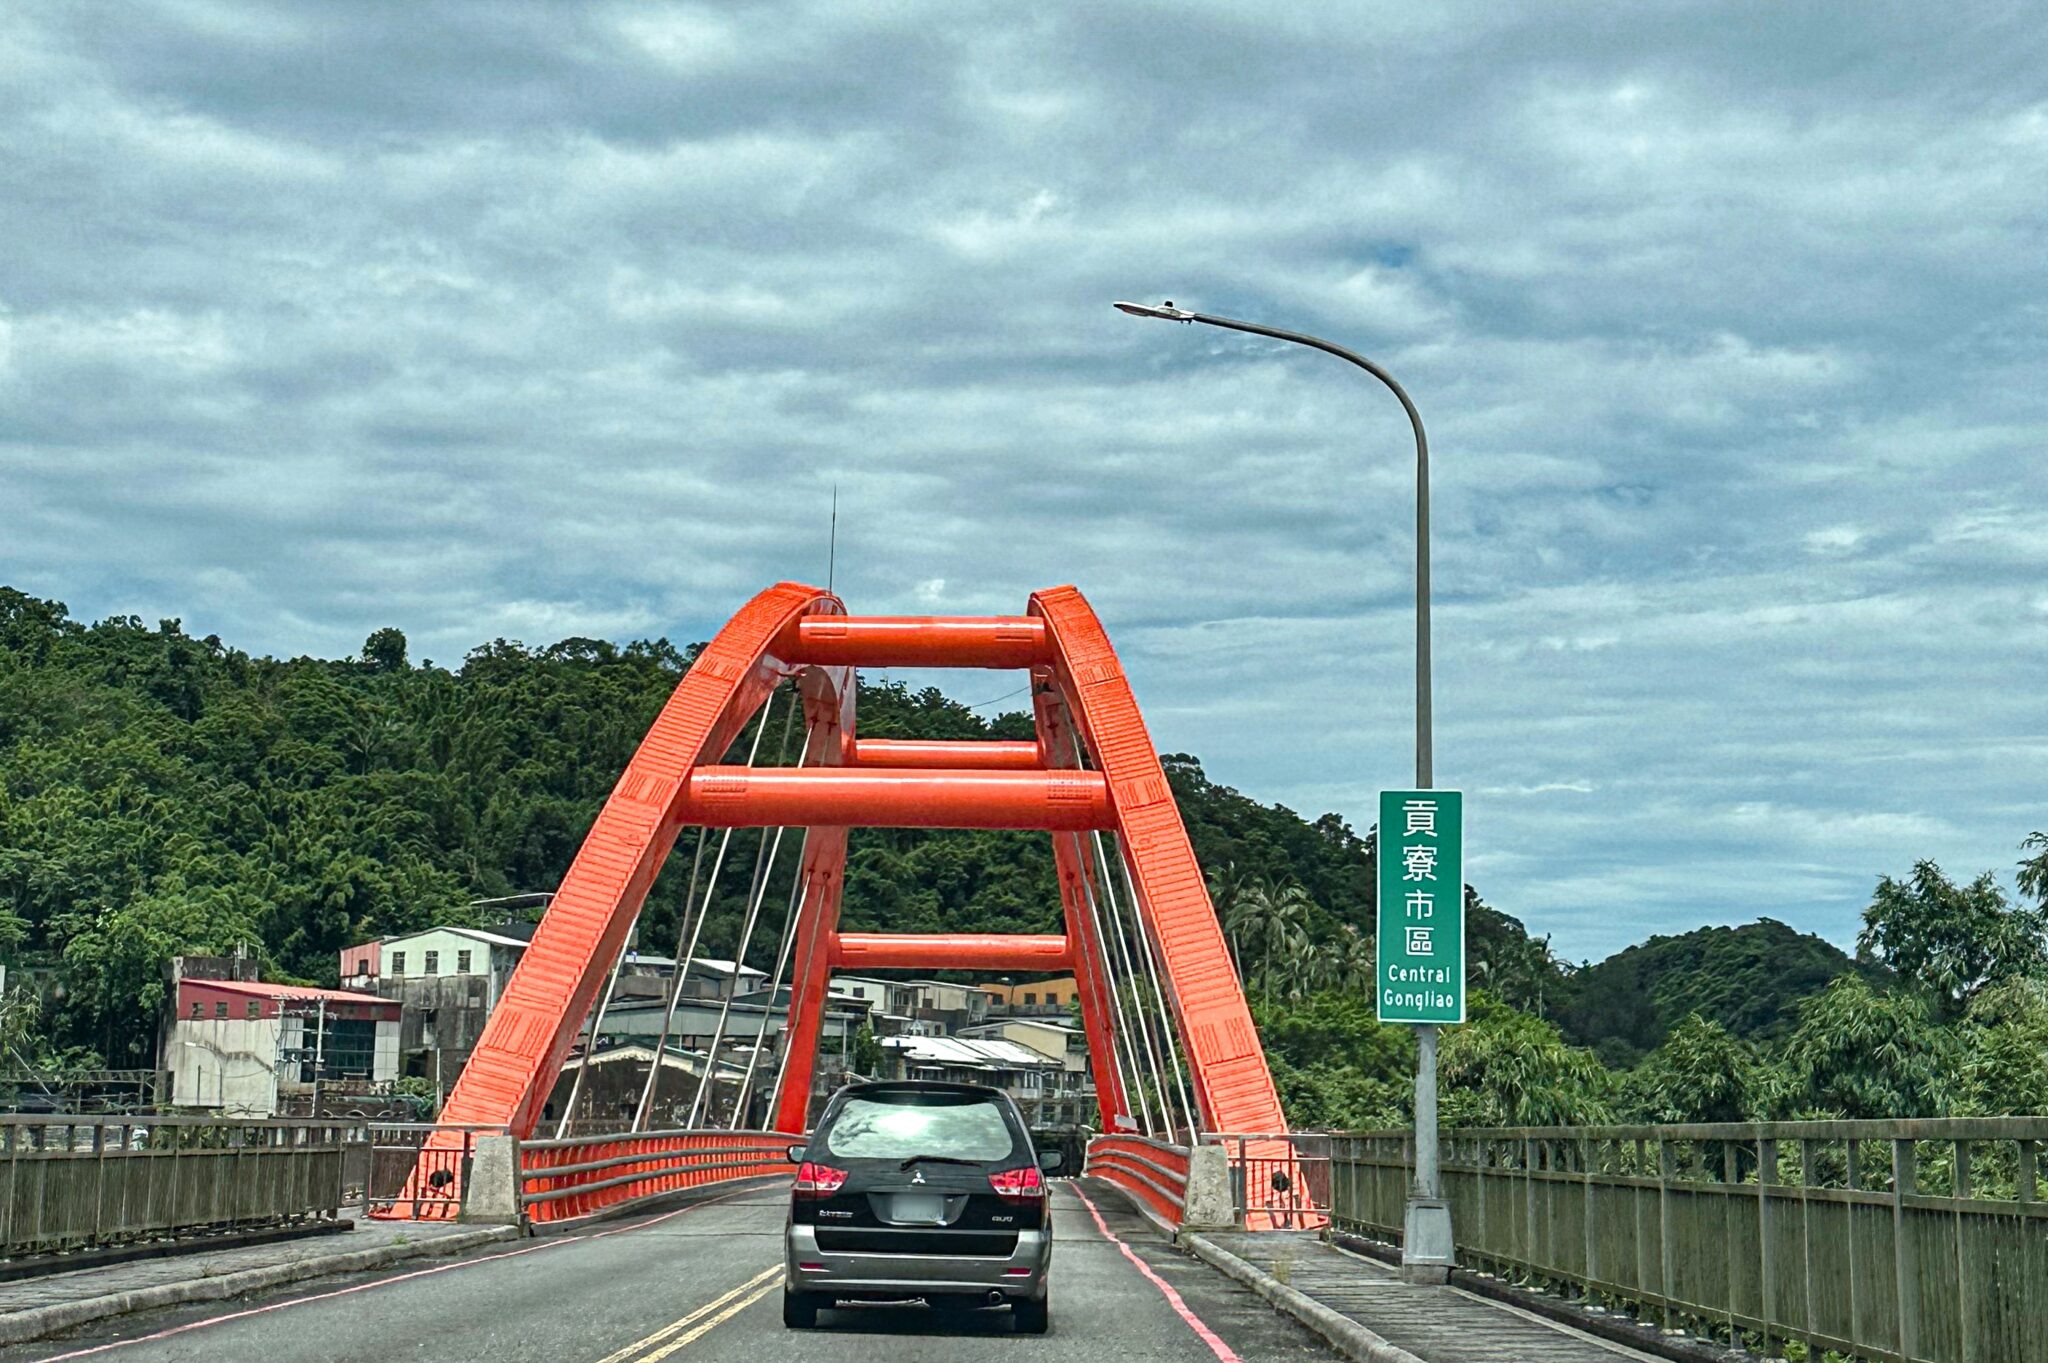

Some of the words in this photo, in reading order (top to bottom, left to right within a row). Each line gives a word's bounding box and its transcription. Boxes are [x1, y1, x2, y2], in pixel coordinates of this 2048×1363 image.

[1402, 800, 1439, 956] 貢寮市區
[1388, 964, 1450, 983] Central
[1384, 988, 1454, 1011] Gongliao
